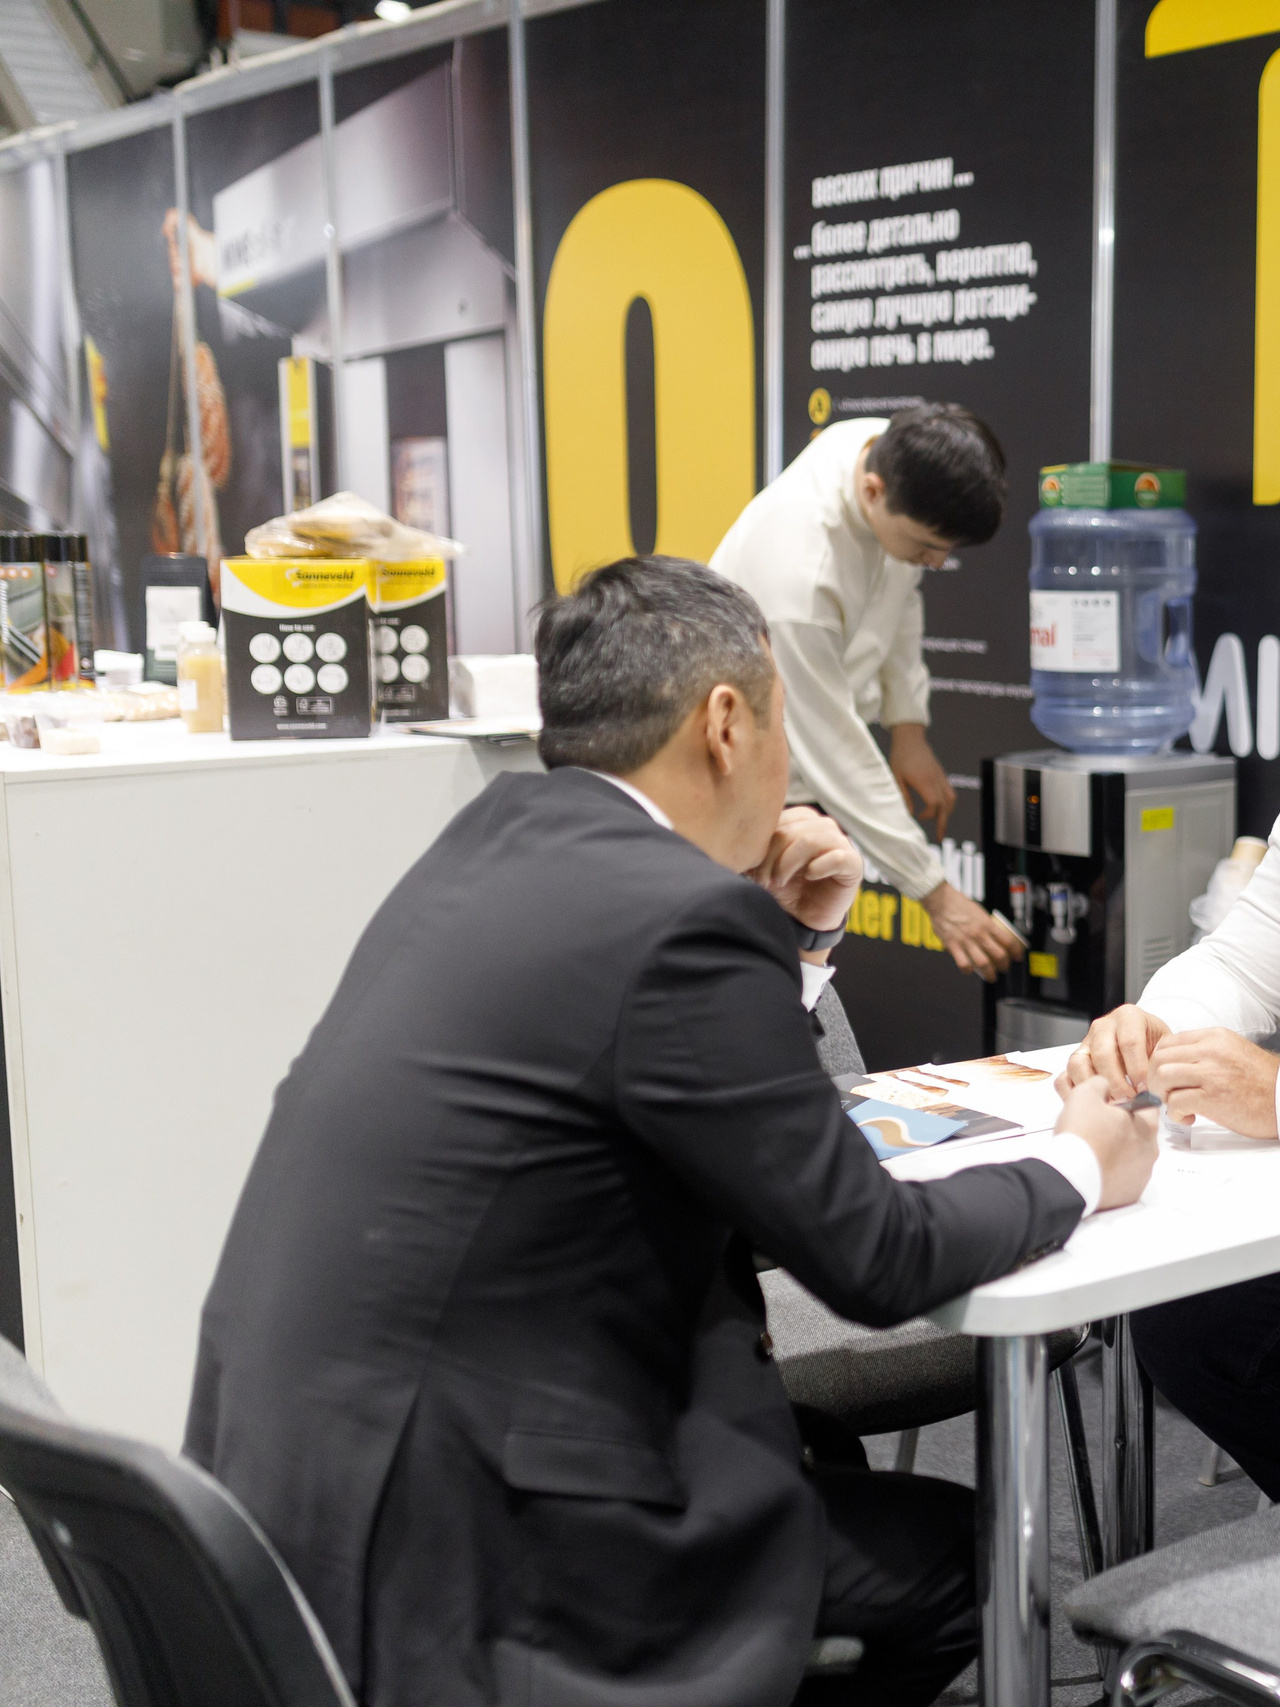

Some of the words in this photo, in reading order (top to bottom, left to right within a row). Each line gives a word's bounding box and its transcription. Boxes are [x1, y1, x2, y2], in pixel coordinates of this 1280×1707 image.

[879, 157, 953, 201] причин
[811, 219, 866, 257] более
[866, 208, 960, 254] детально
[811, 253, 935, 300] рассмотреть,
[935, 241, 1038, 285] вероятно,
[811, 297, 873, 334] самую
[873, 288, 953, 331] лучшую
[869, 332, 916, 367] печь
[916, 334, 932, 363] в
[295, 568, 355, 582] Sonneveld
